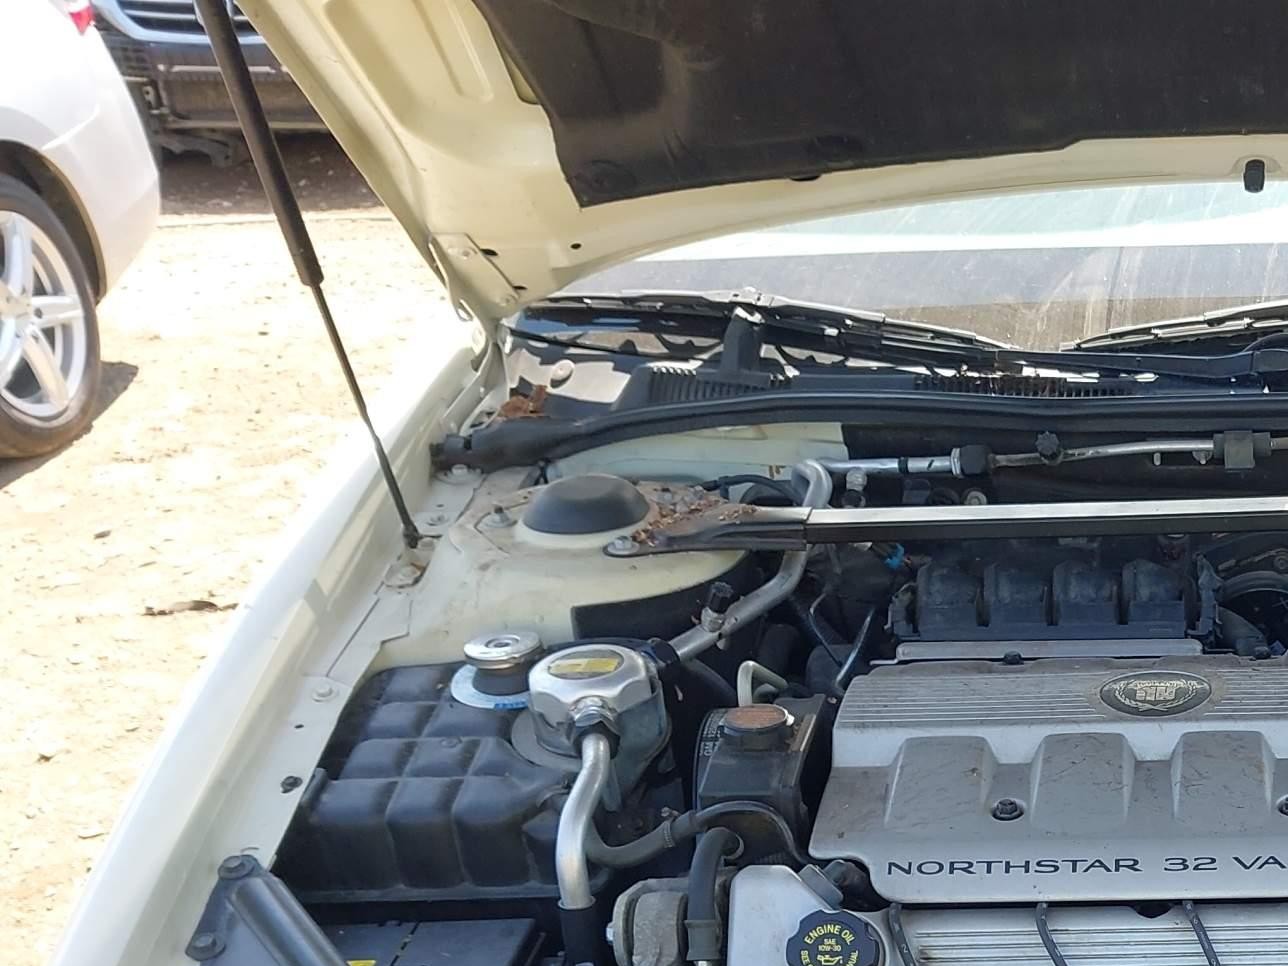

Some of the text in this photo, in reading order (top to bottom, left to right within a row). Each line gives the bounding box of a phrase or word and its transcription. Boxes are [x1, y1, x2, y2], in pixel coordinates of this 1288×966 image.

[887, 858, 1143, 876] NORTHSTAR
[1163, 857, 1218, 872] 32
[804, 924, 856, 946] ENGINE OIL
[818, 944, 842, 952] 10W-30
[801, 949, 811, 966] SEE
